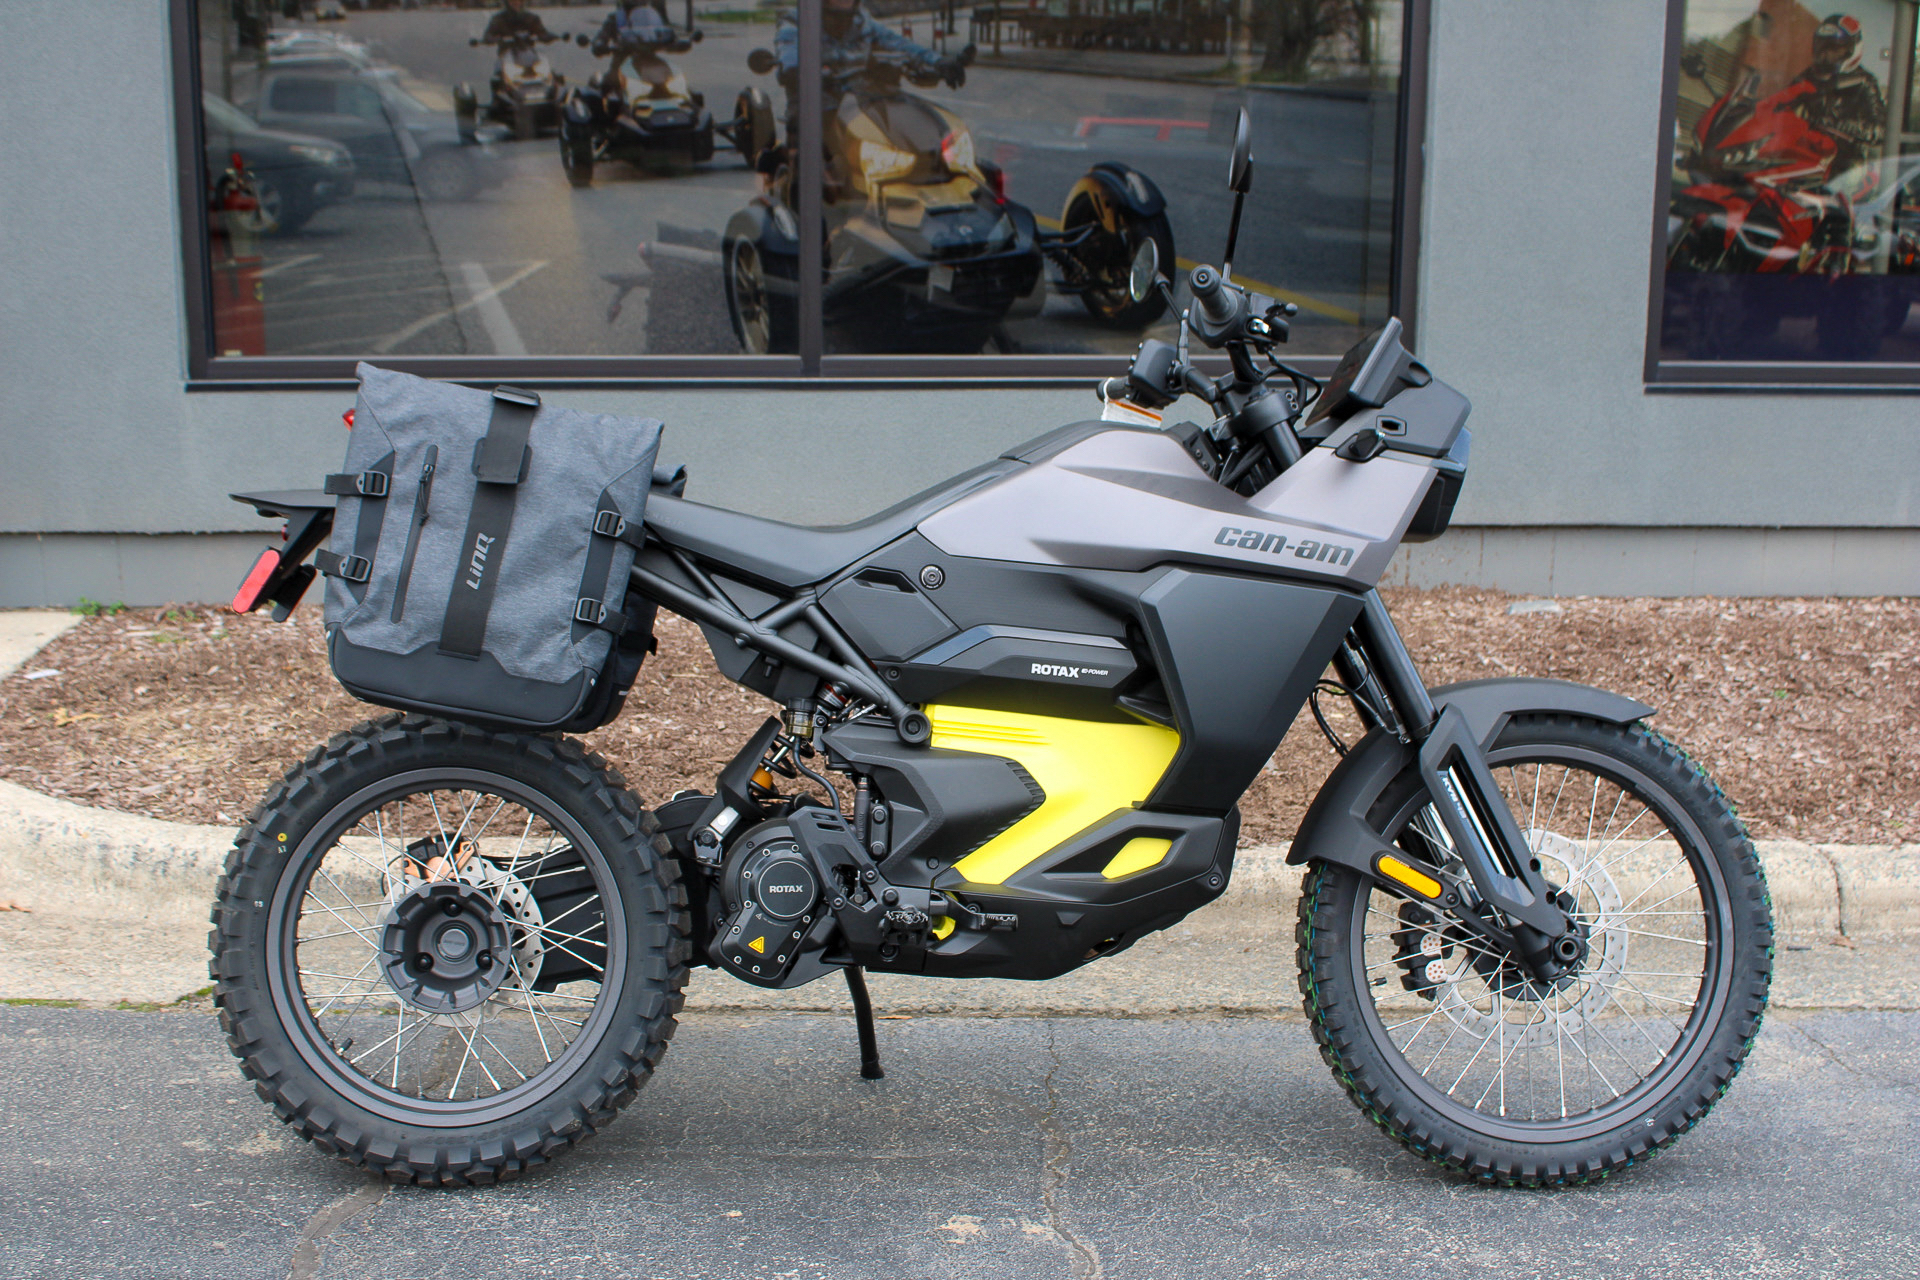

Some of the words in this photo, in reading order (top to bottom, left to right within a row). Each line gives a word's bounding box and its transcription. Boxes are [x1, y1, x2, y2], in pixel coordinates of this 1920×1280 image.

[1214, 526, 1355, 566] can-am
[1031, 663, 1079, 678] ROTAX
[769, 885, 803, 893] ROTAX
